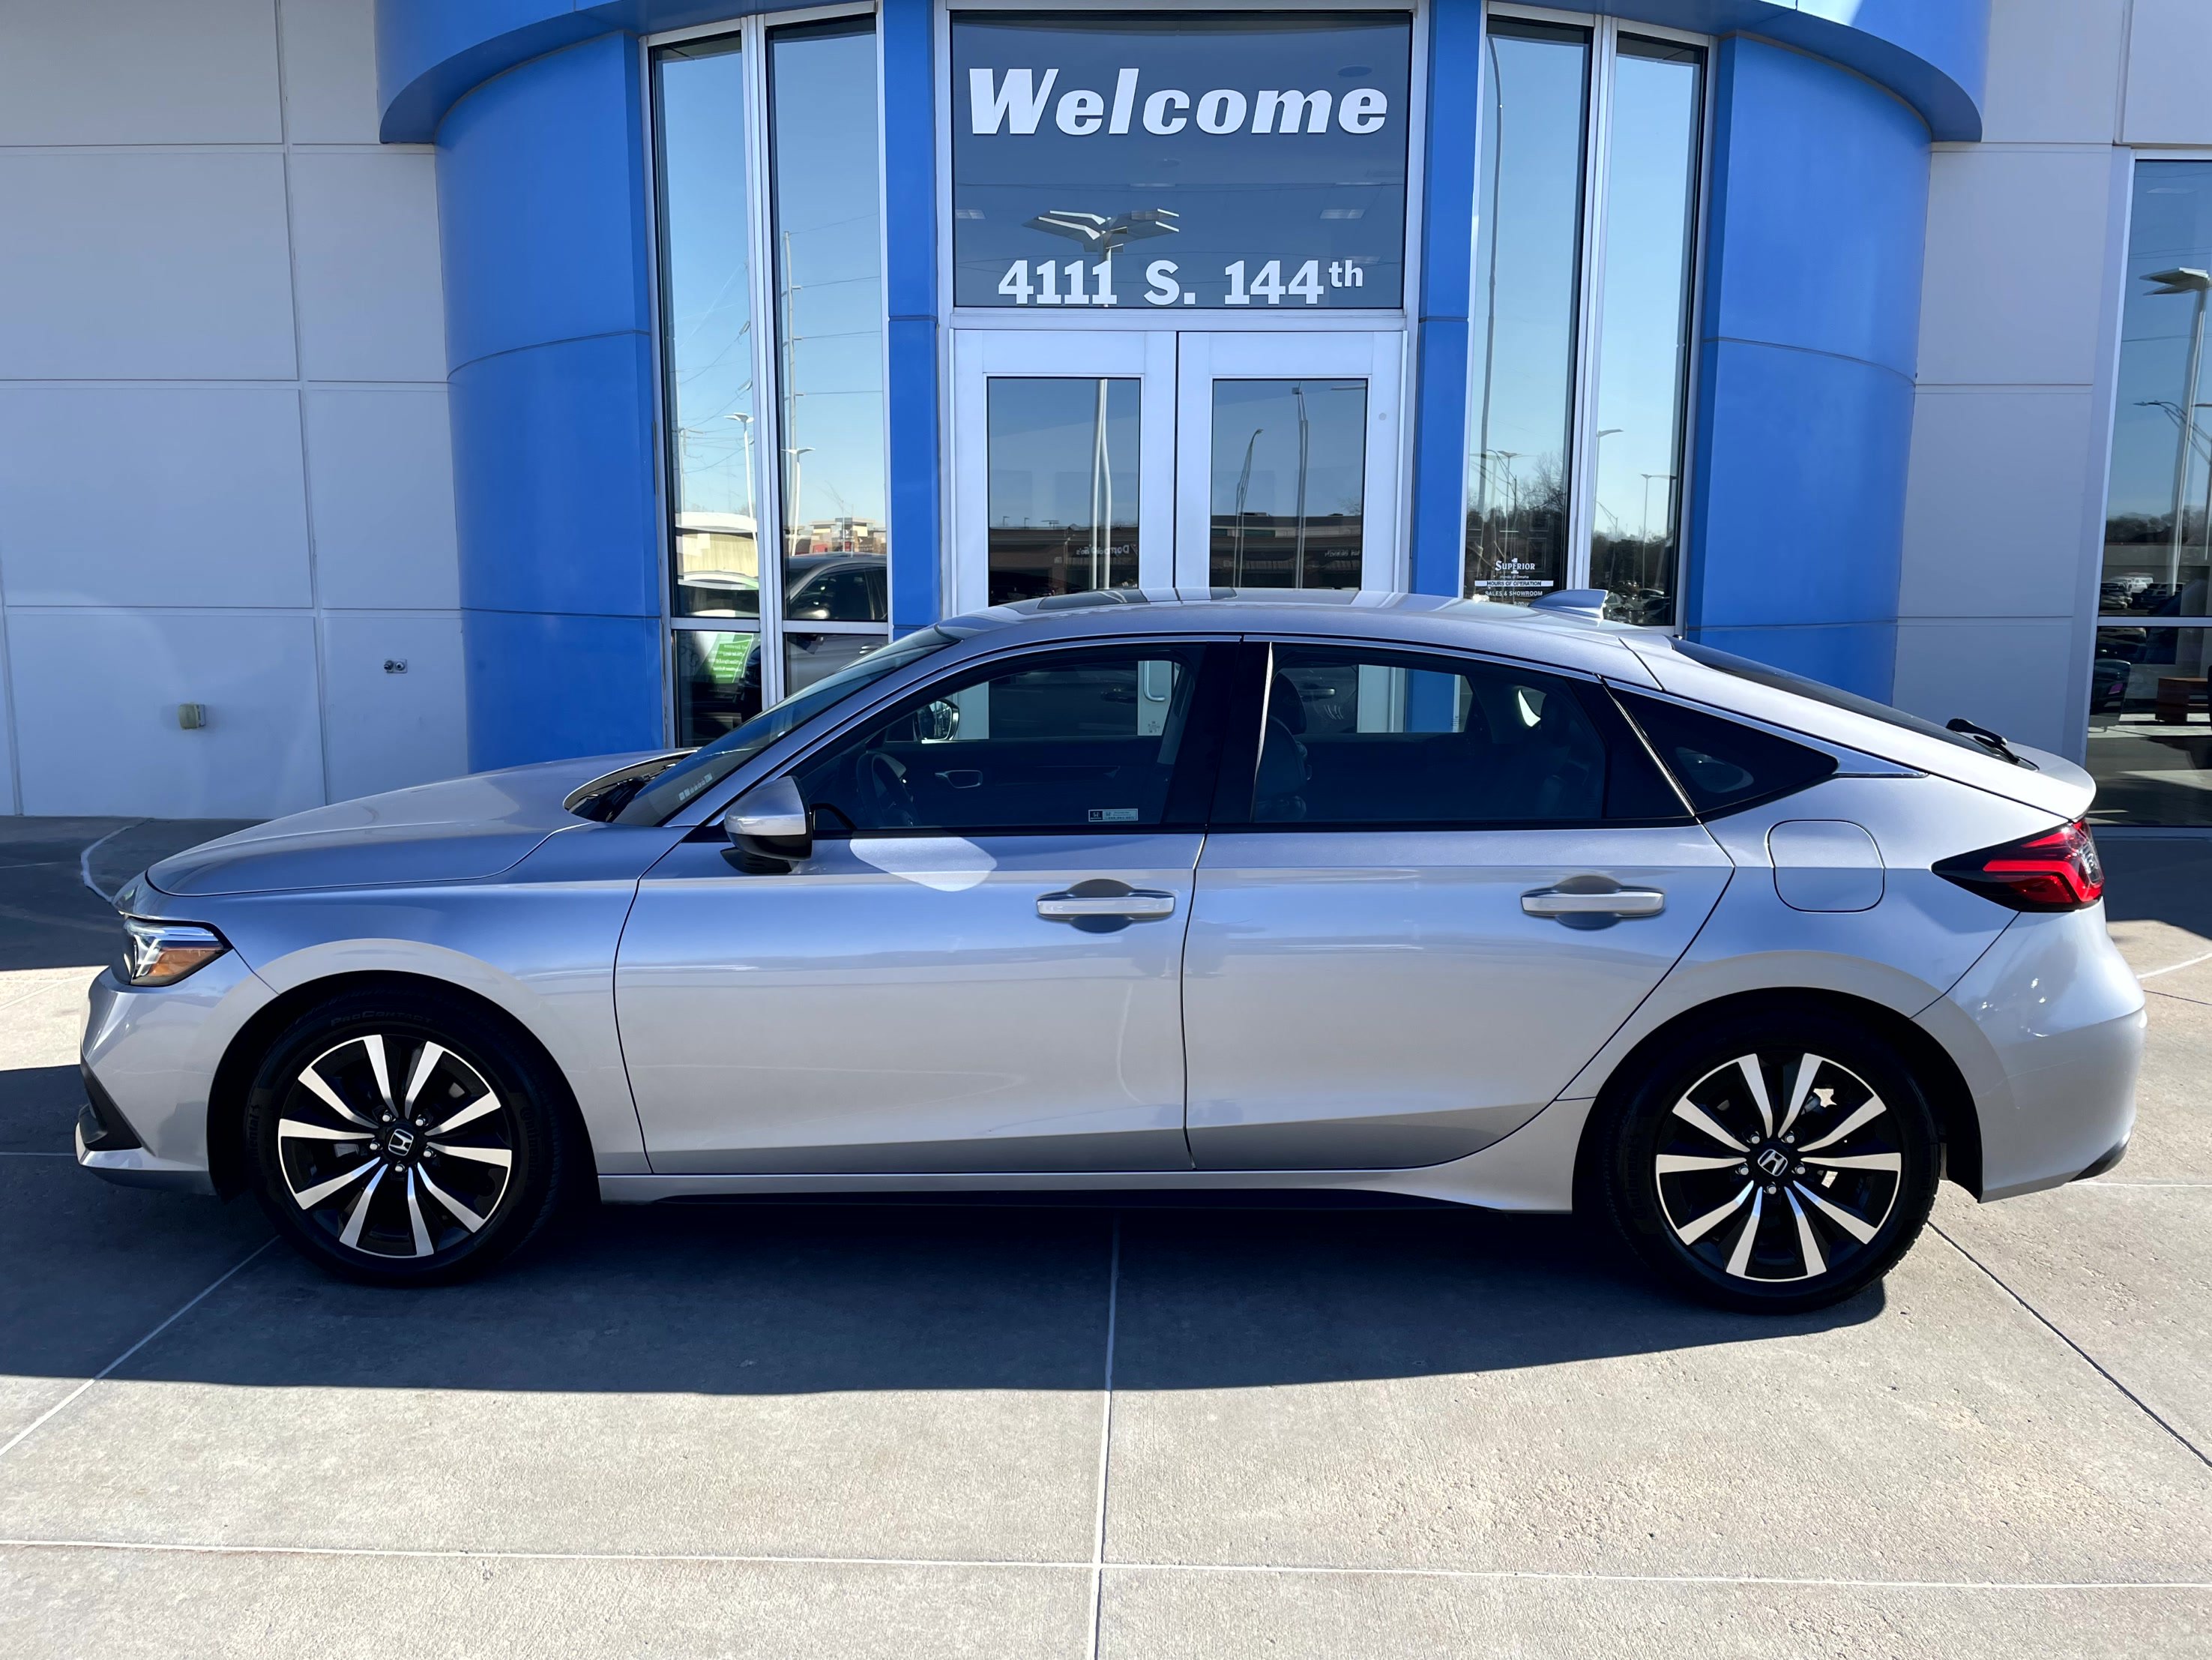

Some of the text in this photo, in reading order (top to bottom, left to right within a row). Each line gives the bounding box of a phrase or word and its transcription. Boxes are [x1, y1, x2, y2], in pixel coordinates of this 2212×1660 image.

[969, 68, 1387, 135] Welcome
[998, 259, 1363, 305] 4111 S. 144th
[1495, 560, 1535, 571] SUPERIOR
